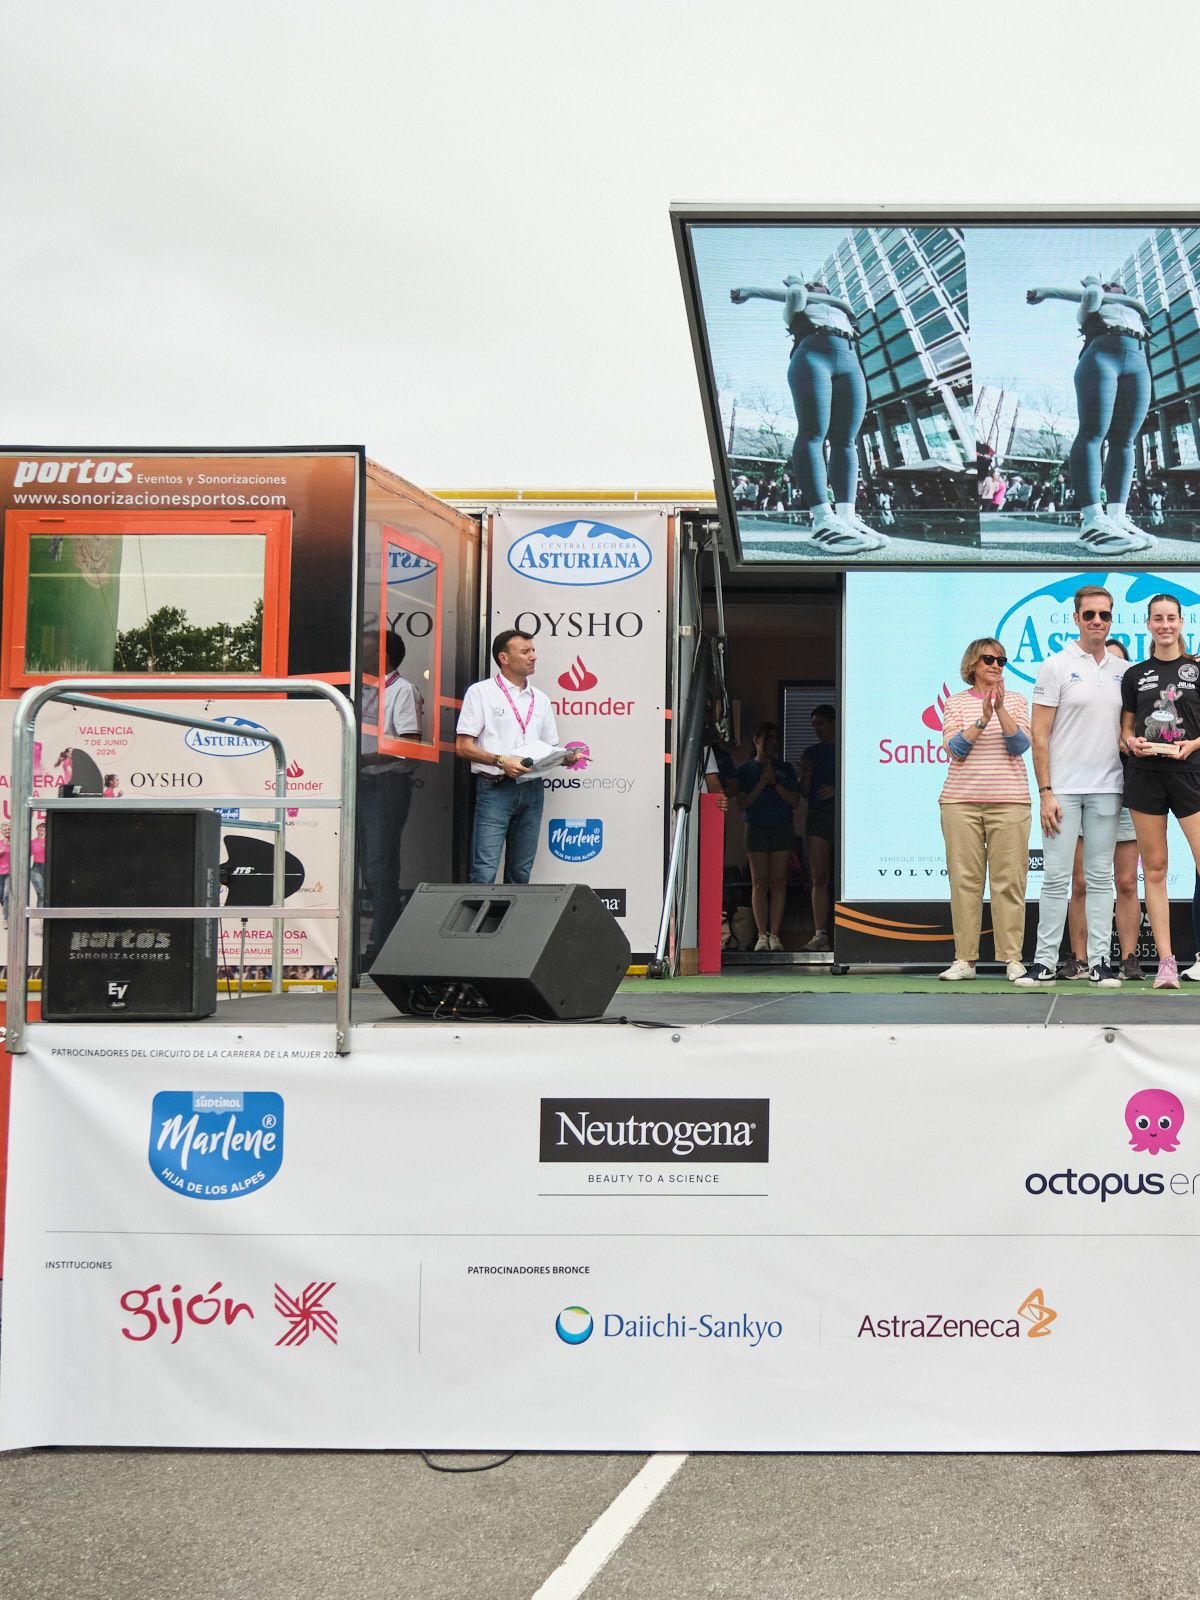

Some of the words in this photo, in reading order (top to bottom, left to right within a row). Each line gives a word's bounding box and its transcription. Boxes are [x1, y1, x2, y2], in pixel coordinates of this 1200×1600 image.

[13, 459, 134, 488] portos
[137, 473, 183, 485] Eventos
[187, 476, 194, 486] y
[198, 473, 287, 485] Sonorizaciones
[13, 492, 287, 507] www.sonorizacionesportos.com
[518, 544, 641, 569] ASTURIANA
[514, 611, 643, 638] OYSHO
[551, 697, 635, 716] ntander
[79, 727, 133, 735] VALENCIA
[879, 739, 950, 764] Santa
[130, 772, 204, 788] OYSHO
[265, 780, 323, 791] Satander
[542, 778, 580, 792] opus
[582, 778, 636, 793] energy
[552, 828, 600, 851] Marlene
[71, 929, 171, 951] portos
[284, 930, 307, 939] OSA
[51, 1049, 129, 1057] PATROCINADORES
[131, 1049, 147, 1057] DEL
[193, 1050, 204, 1058] DE
[207, 1050, 218, 1058] LA
[291, 1051, 321, 1059] MUJER
[157, 1114, 276, 1171] Marlene
[555, 1111, 753, 1156] Neutrogena
[162, 1168, 184, 1189] HIJA
[187, 1182, 202, 1194] DE
[205, 1185, 228, 1195] LOS
[231, 1171, 266, 1193] ALPES
[588, 1174, 634, 1183] BEAUTY
[638, 1174, 653, 1183] TO
[657, 1174, 665, 1183] A
[669, 1174, 720, 1183] SCIENCE
[1025, 1168, 1165, 1203] octopus
[45, 1261, 113, 1270] INSTITUCIONES
[467, 1265, 551, 1274] PATROCINADORES
[552, 1265, 590, 1274] BRONCE
[120, 1281, 255, 1345] gijón
[603, 1313, 783, 1347] Daiichi-Sankyo
[857, 1314, 1020, 1338] AstraZeneca
